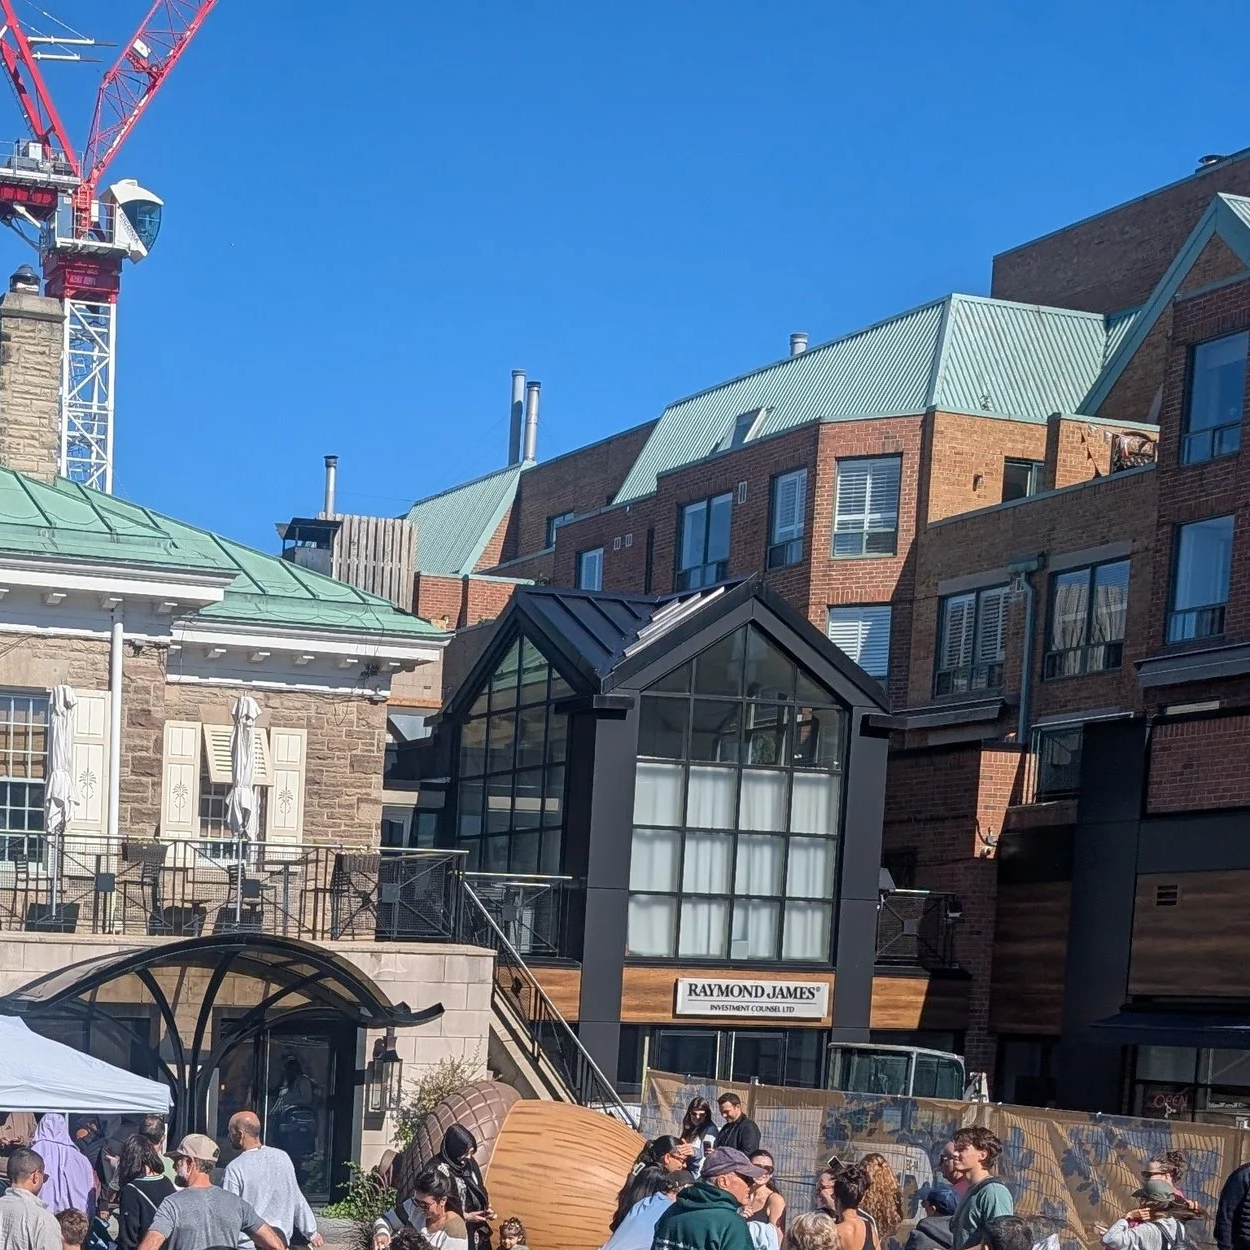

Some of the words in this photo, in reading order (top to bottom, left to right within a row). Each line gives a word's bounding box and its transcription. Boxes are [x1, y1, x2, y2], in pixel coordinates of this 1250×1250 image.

[688, 982, 765, 998] RAYMOND
[710, 1004, 750, 1012] INVESTMENT
[751, 1004, 781, 1013] COUNSEL
